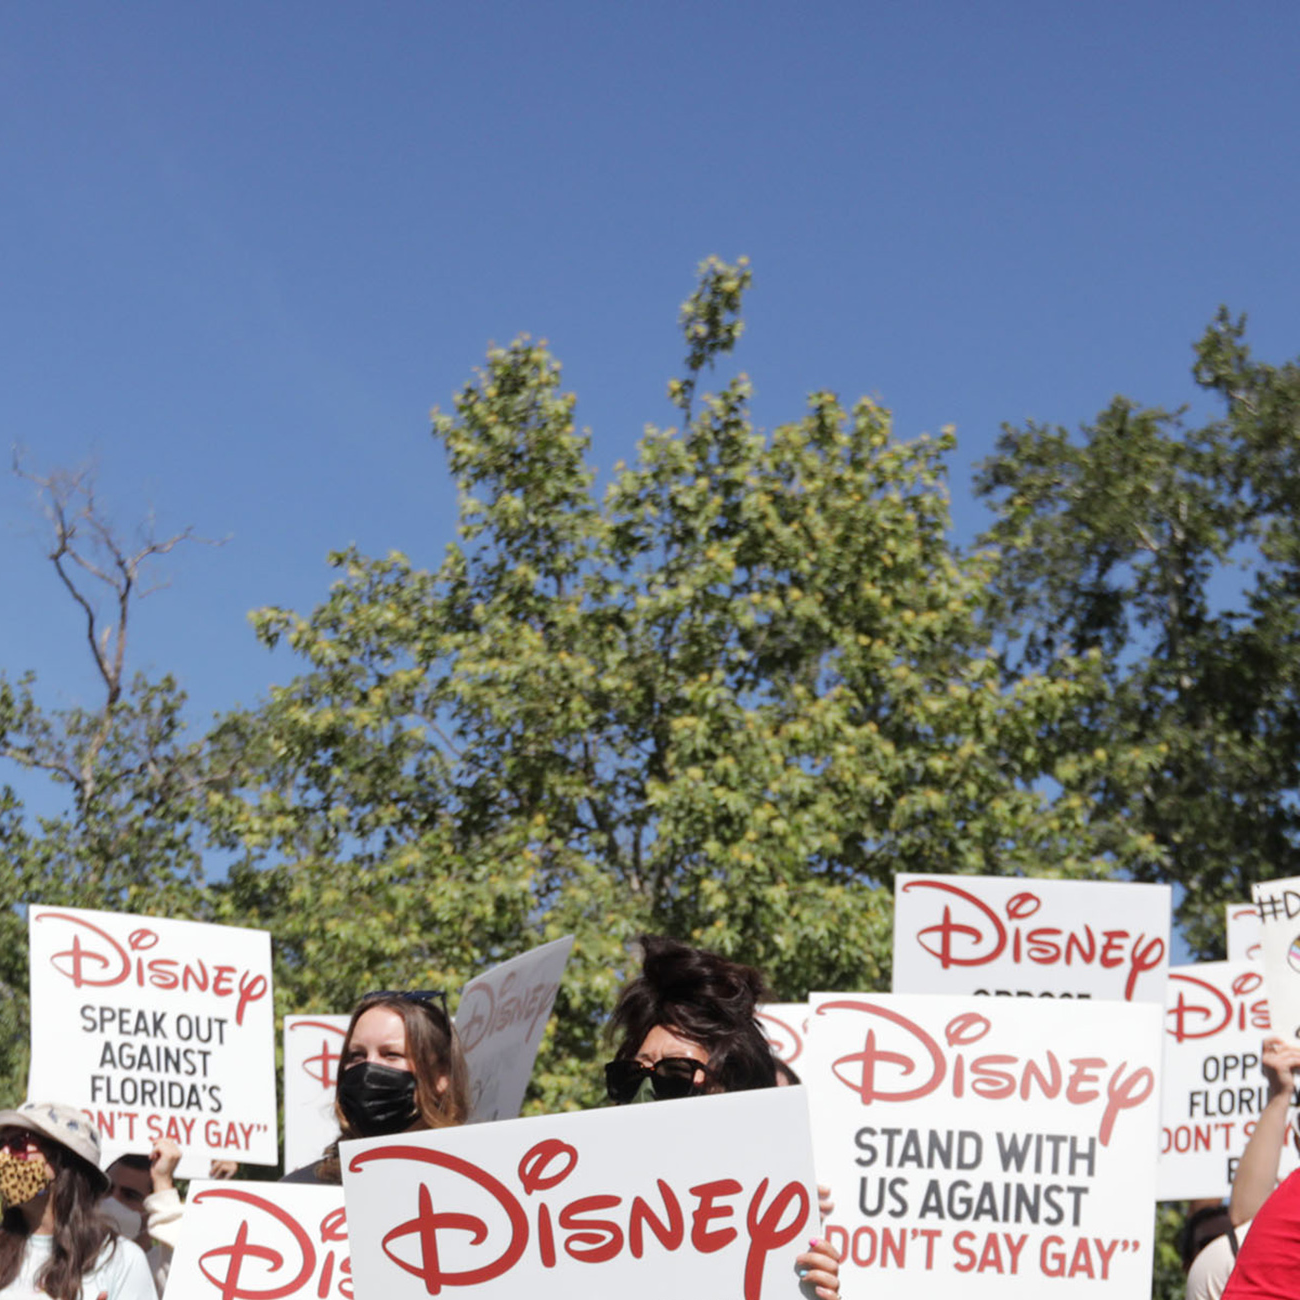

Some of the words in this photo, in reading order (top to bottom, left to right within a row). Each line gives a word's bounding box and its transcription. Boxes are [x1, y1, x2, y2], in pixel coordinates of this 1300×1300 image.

[80, 1004, 167, 1040] SPEAK
[176, 1013, 228, 1046] OUT
[99, 1041, 212, 1078] AGAINST
[1202, 1053, 1258, 1083] OPP
[91, 1075, 223, 1114] FLORIDA'S
[147, 1114, 197, 1146] SAY
[205, 1119, 268, 1151] GAY"
[854, 1127, 983, 1171] STAND
[996, 1131, 1096, 1177] WITH
[859, 1176, 909, 1218] US
[918, 1179, 1089, 1227] AGAINST
[824, 1225, 942, 1270] DON'T
[953, 1230, 1029, 1275] SAY
[1039, 1235, 1140, 1280] GAY"
